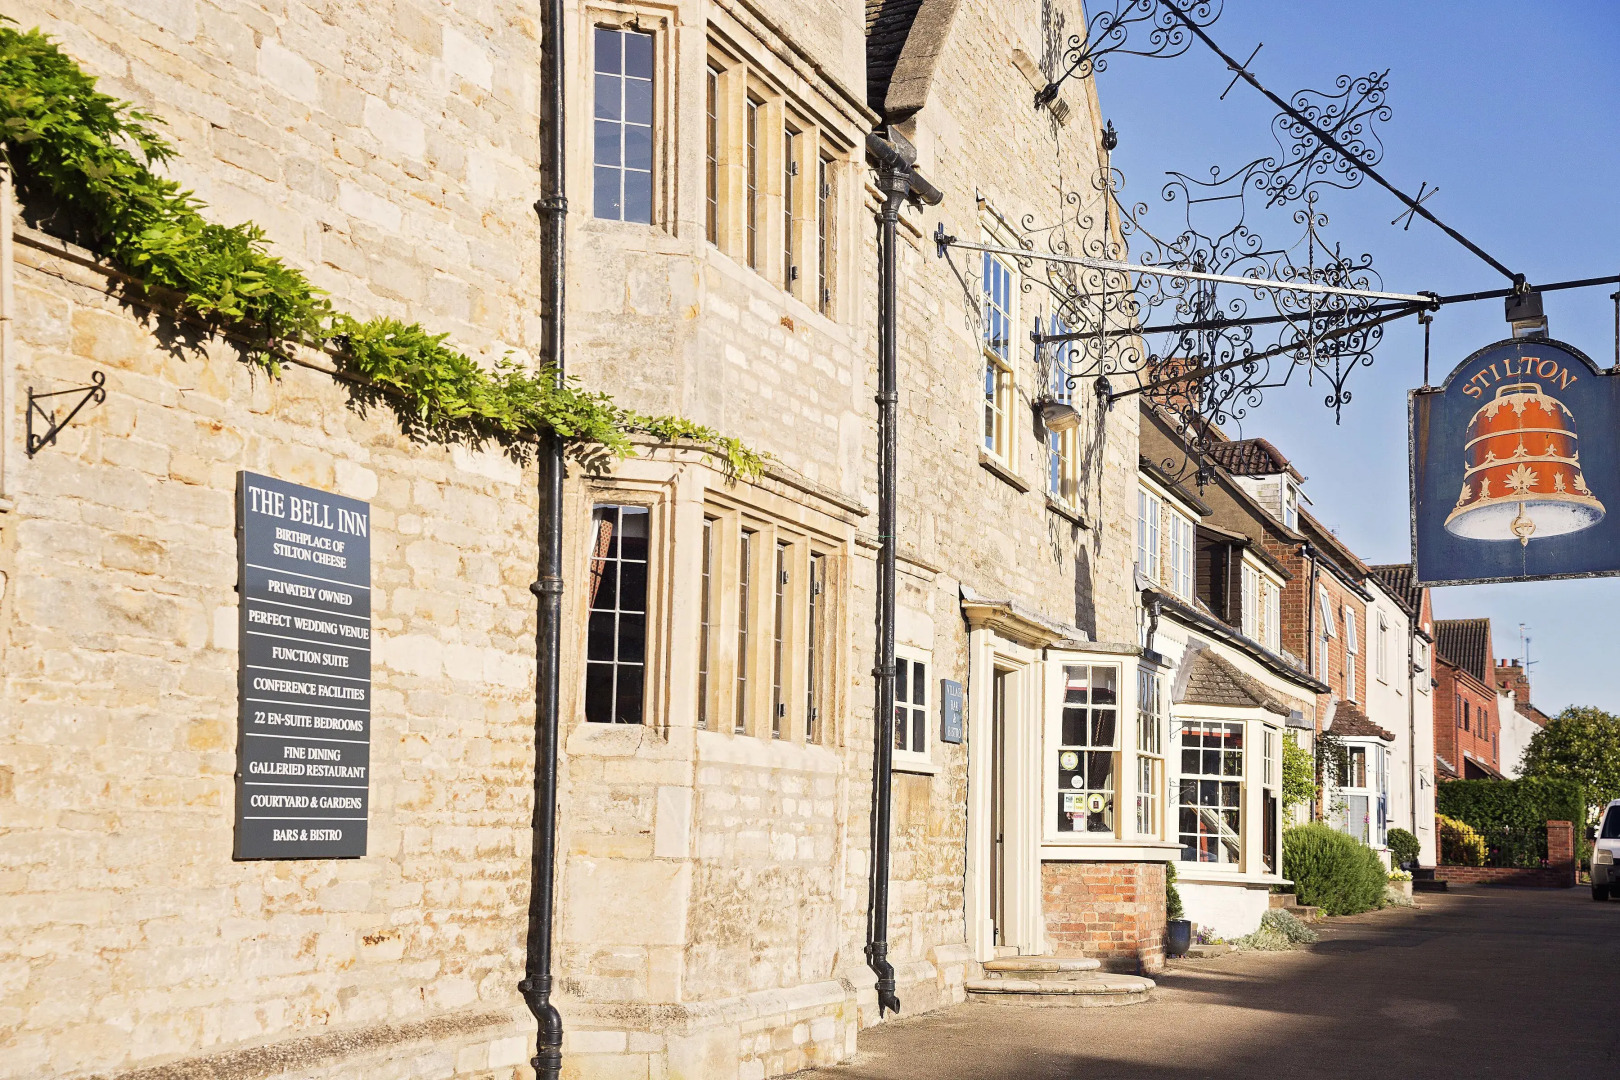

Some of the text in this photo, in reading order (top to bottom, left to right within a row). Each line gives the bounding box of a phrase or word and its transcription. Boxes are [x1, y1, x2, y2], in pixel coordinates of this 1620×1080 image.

[1462, 356, 1579, 399] STILTON
[248, 486, 367, 538] THE BELL INN
[276, 527, 345, 553] BIRTHPLACE OF
[273, 542, 346, 568] STILTON CHEESE
[268, 580, 352, 606] PRIVATELY OWNED
[248, 610, 370, 640] PERFECT WEDDING VENUE
[272, 646, 349, 668] FUNCTION SUITE
[254, 678, 364, 700] CONFERENCE FACILITIES
[254, 712, 363, 732] 22 EN-SUITE BEDROOMS
[284, 746, 340, 761] FINE DINING
[250, 762, 366, 778] GALLERIED RESTAURANT
[250, 794, 362, 809] COURTYARD & GARDENS
[273, 830, 342, 842] BARS & BISTRO
